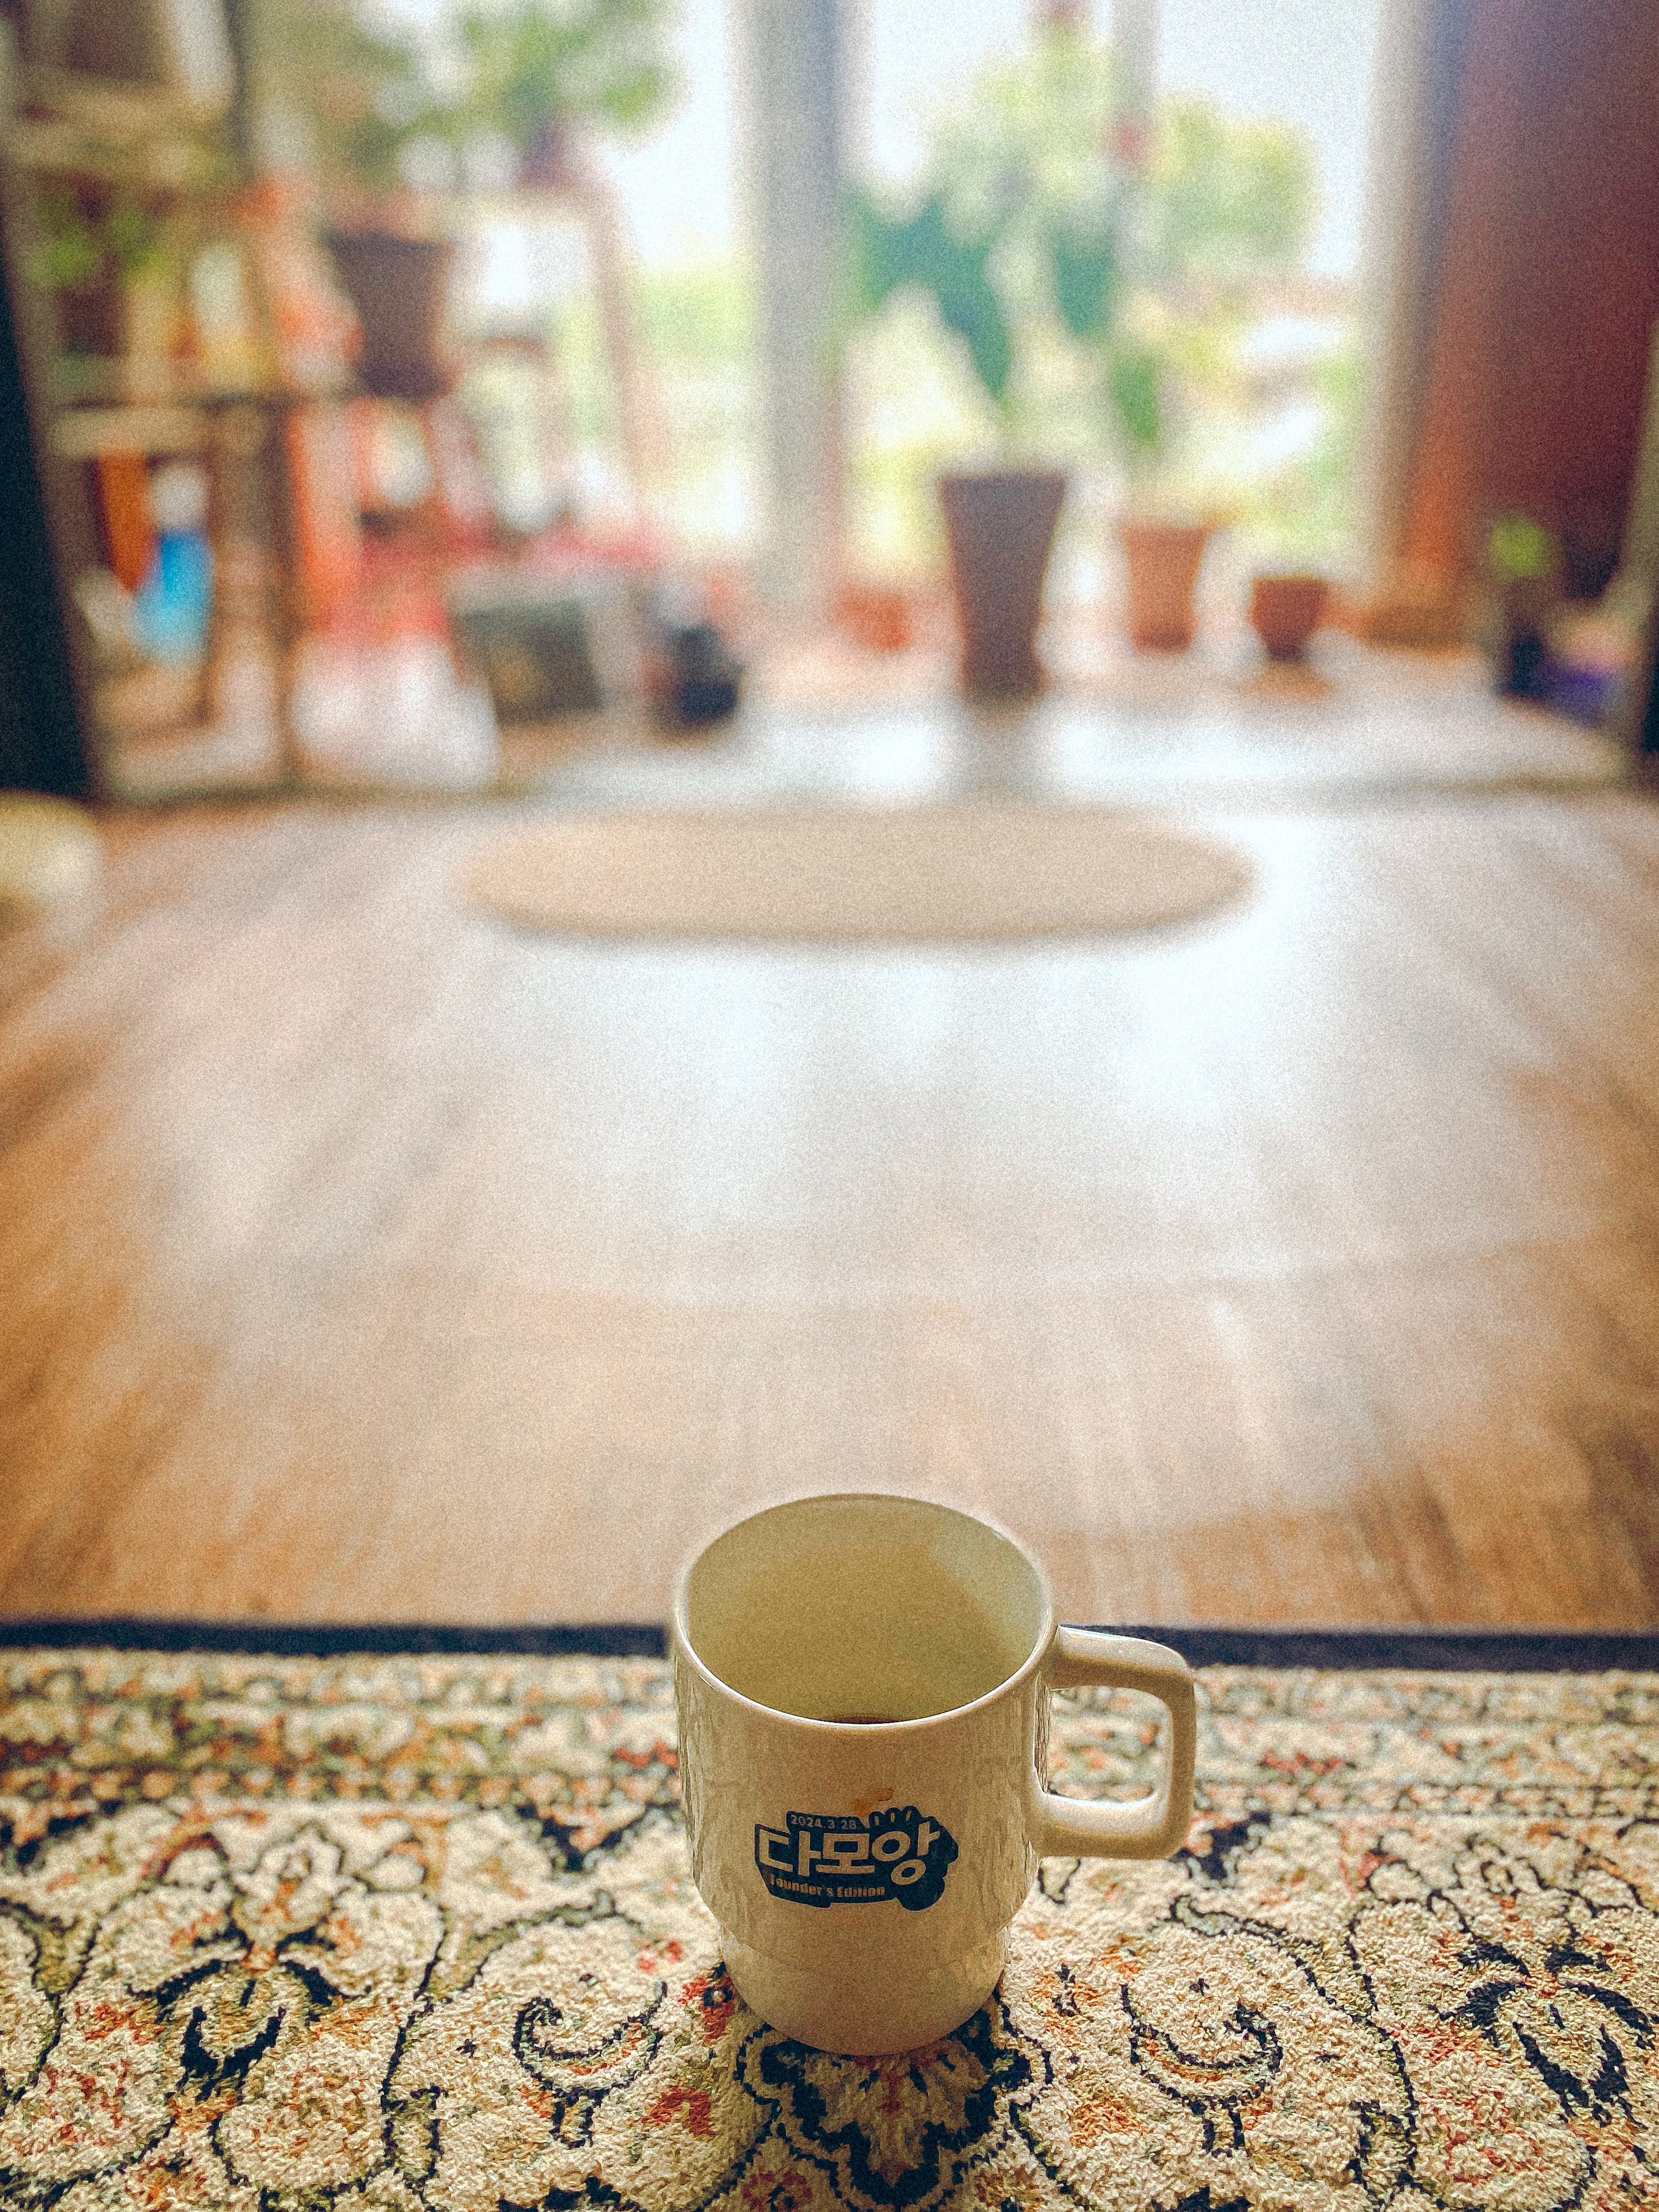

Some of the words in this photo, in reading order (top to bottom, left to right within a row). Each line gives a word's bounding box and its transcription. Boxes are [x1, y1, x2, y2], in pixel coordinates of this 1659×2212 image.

[759, 1822, 941, 1885] 다모앙
[770, 1874, 833, 1897] Founder's
[837, 1886, 885, 1897] Edition
